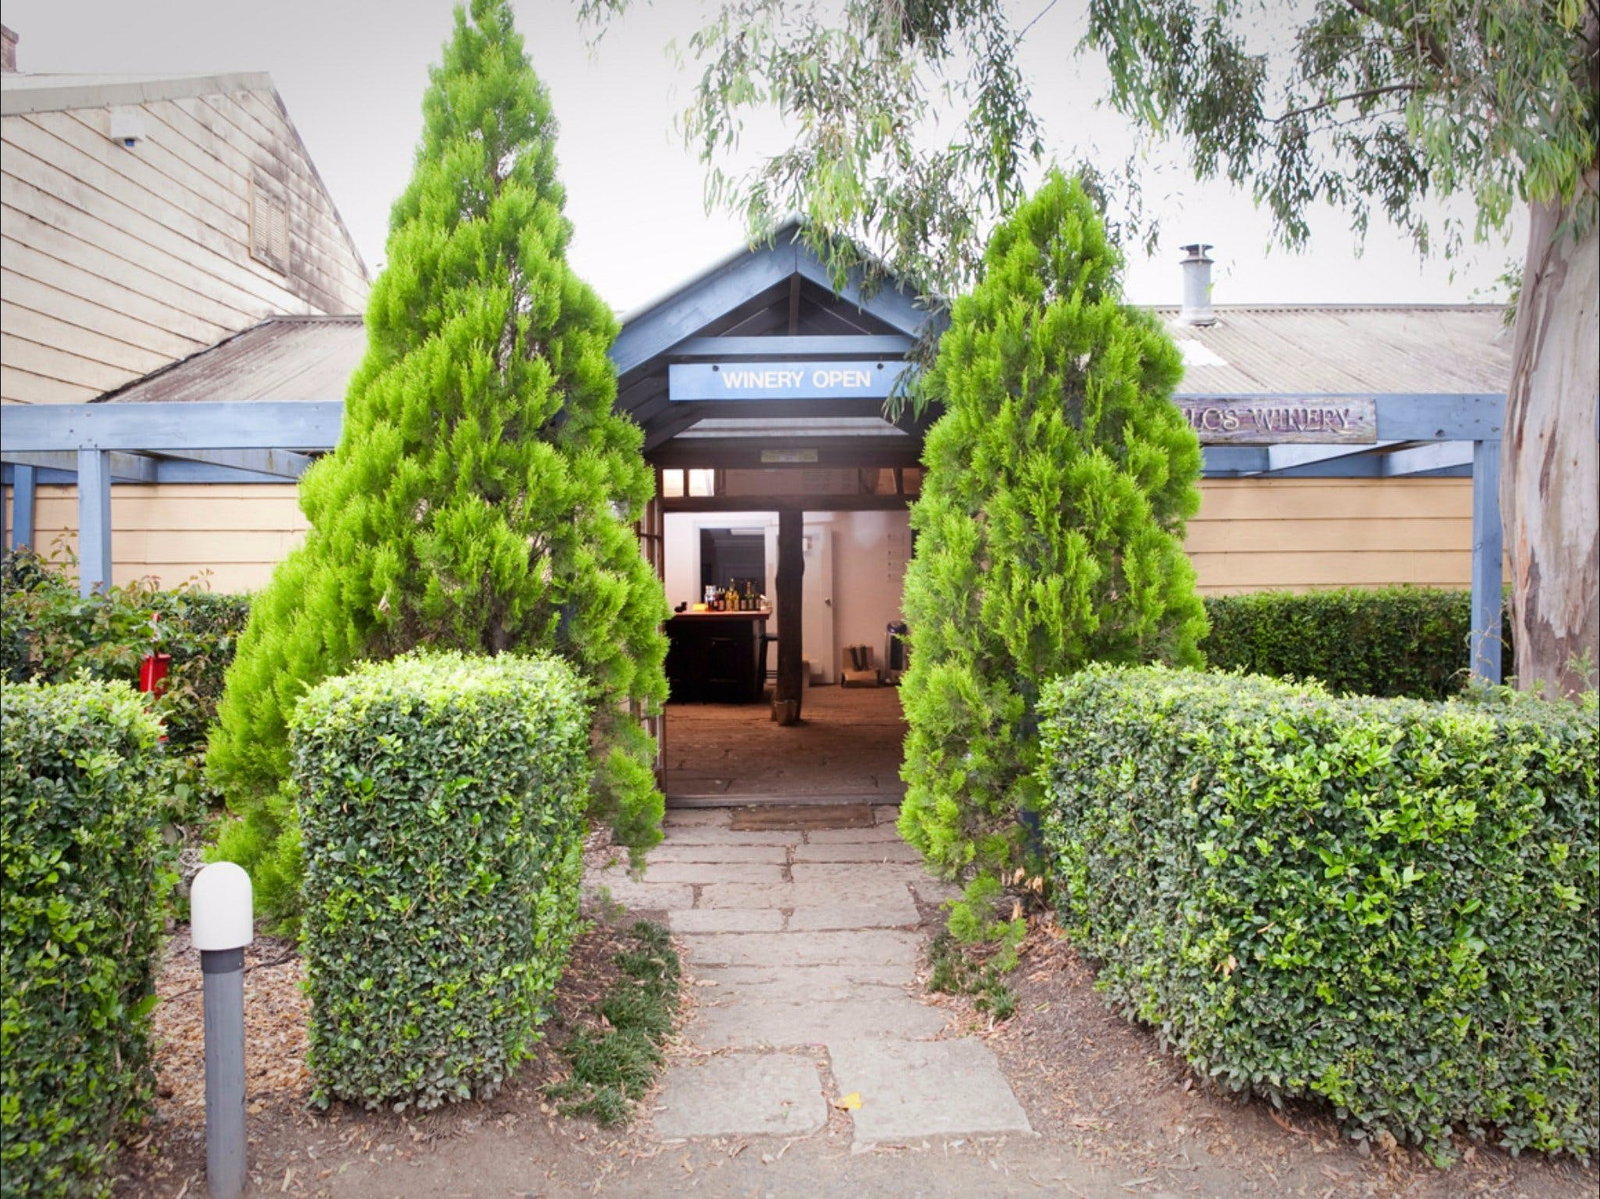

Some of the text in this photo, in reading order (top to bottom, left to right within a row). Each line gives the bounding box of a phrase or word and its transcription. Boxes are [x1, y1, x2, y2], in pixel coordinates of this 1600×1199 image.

[723, 370, 871, 389] WINERY OPEN
[1247, 407, 1351, 433] WINERY
